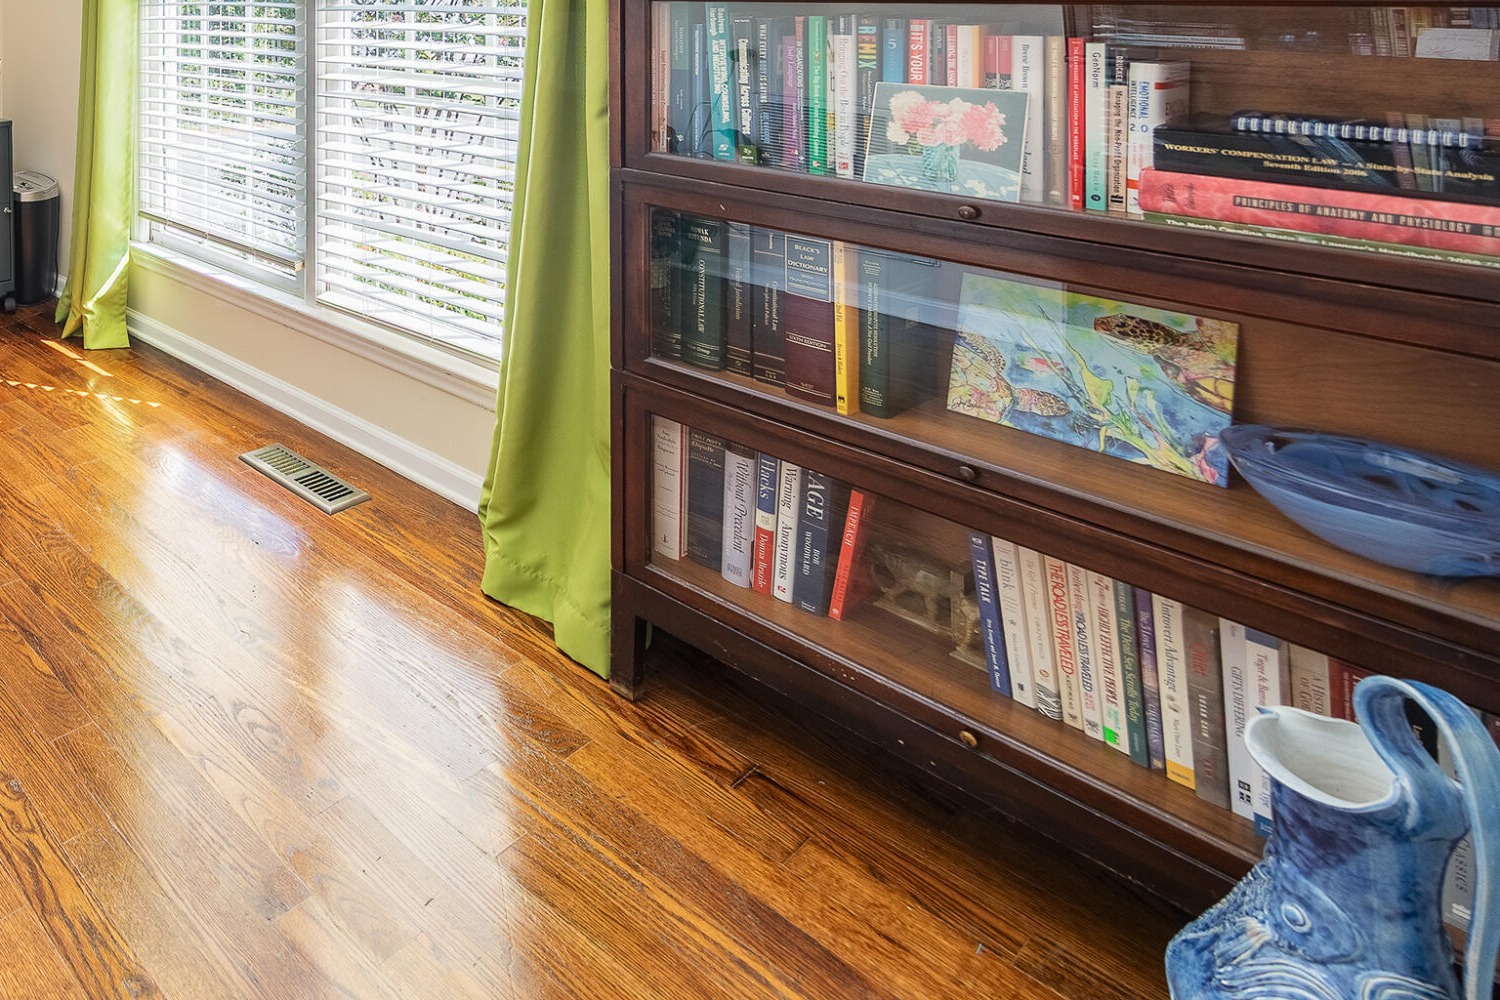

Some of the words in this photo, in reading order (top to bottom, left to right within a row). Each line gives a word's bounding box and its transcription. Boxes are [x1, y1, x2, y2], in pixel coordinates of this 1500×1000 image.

[759, 24, 767, 39] WHAT
[888, 39, 897, 49] 5
[910, 32, 923, 50] IT'S
[759, 41, 768, 58] EVERY
[858, 25, 876, 69] REMIX
[910, 54, 924, 81] YOUR
[1021, 66, 1030, 88] Brown
[1092, 52, 1101, 88] GenNorm
[1115, 55, 1123, 82] DRUCKER
[740, 85, 751, 106] Across
[1113, 90, 1123, 117] Managing
[1129, 80, 1137, 118] INTELLIGENCE
[1138, 81, 1150, 119] EMOTIONAL
[742, 108, 752, 135] Cultures
[1164, 143, 1220, 155] WORKERS'
[1221, 149, 1311, 164] COMPENSATION
[1311, 157, 1338, 166] LAW
[1444, 171, 1495, 182] Analysis
[1263, 161, 1301, 170] Seventh
[1303, 165, 1341, 174] Edition
[1343, 169, 1368, 177] 2006
[1234, 196, 1293, 213] PRINCIPLES
[1298, 203, 1311, 213] OF
[1315, 206, 1366, 220] ANATOMY
[1371, 213, 1394, 224] AND
[1399, 216, 1472, 233] PHYSIOLOGY
[794, 244, 821, 255] BLACK'S
[800, 254, 816, 262] LAW
[787, 259, 828, 274] DICTIONARY
[733, 460, 751, 503] Without
[759, 458, 776, 500] Hacks
[781, 468, 797, 510] Warning
[732, 503, 750, 554] Precedent
[844, 506, 859, 547] IMPEACH
[759, 533, 769, 560] Donna
[778, 521, 793, 580] Anonymous
[802, 531, 812, 576] WOODWARD
[813, 549, 821, 565] BOB
[976, 559, 988, 580] TYPE
[1000, 559, 1015, 591] blink
[1049, 564, 1063, 582] THE
[979, 581, 992, 602] TALK
[1051, 581, 1067, 610] ROAD
[1094, 581, 1109, 591] 7
[1054, 609, 1069, 629] LESS
[1097, 606, 1111, 636] HIGHLY
[1121, 618, 1131, 633] The
[1139, 611, 1149, 623] The
[1161, 602, 1174, 643] Introvert
[1055, 628, 1075, 675] TRAVELED
[1099, 635, 1116, 677] EFFECTIVE
[1121, 634, 1135, 656] Dead
[1123, 657, 1134, 670] Sea
[1163, 643, 1178, 693] Advantage
[1190, 642, 1209, 677] Quiet
[1080, 655, 1093, 693] TRAVELED
[1126, 673, 1138, 698] Scrolls
[1231, 665, 1244, 691] GIFTS
[1299, 677, 1309, 688] OF
[1104, 677, 1118, 707] PEOPLE
[1128, 700, 1141, 724] Today
[1198, 694, 1208, 718] SUSAN
[1232, 691, 1246, 738] DIFFERING
[1148, 704, 1160, 744] CHAPMAN
